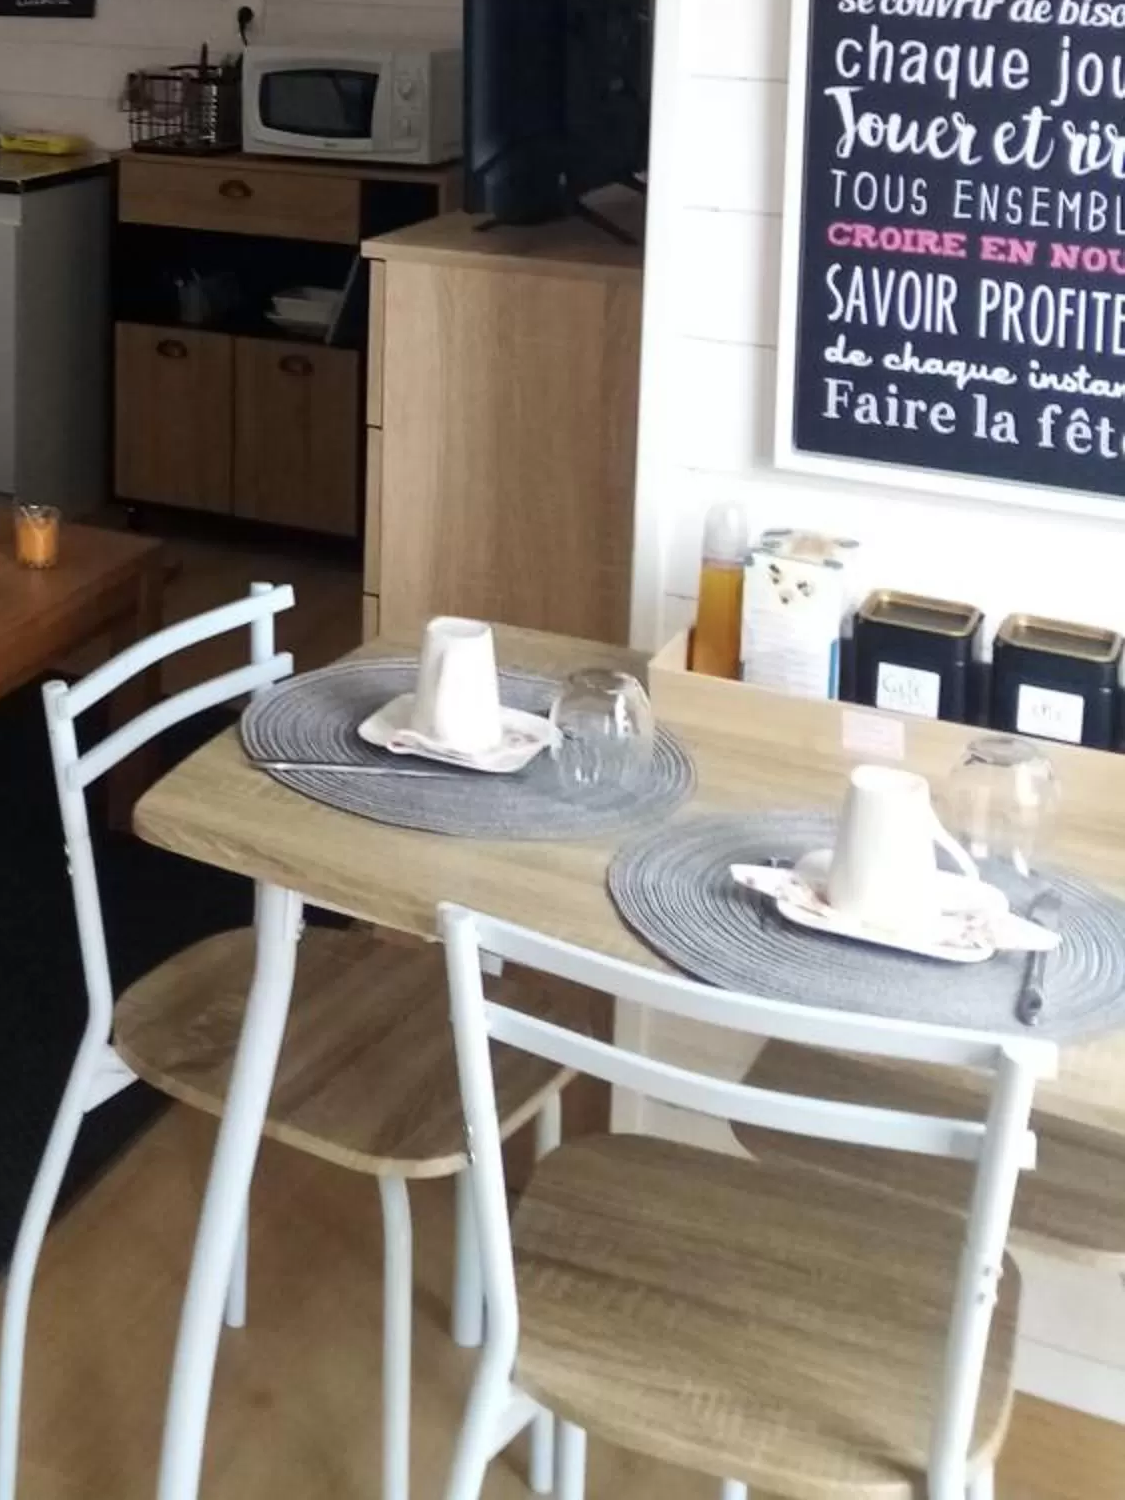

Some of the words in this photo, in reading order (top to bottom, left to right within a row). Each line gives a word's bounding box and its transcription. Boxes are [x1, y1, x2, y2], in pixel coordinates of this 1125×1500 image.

[835, 24, 1030, 100] chaque
[823, 85, 983, 166] Jouer
[993, 105, 1056, 170] et
[830, 169, 928, 216] TOUS
[827, 222, 967, 259] CROIRE
[979, 235, 1038, 267] EN
[826, 263, 958, 335] SAVOIR
[824, 333, 873, 366] de
[882, 341, 1018, 390] chaque
[822, 377, 957, 434] Faire
[973, 393, 1019, 445] la
[1037, 403, 1125, 459] fêt
